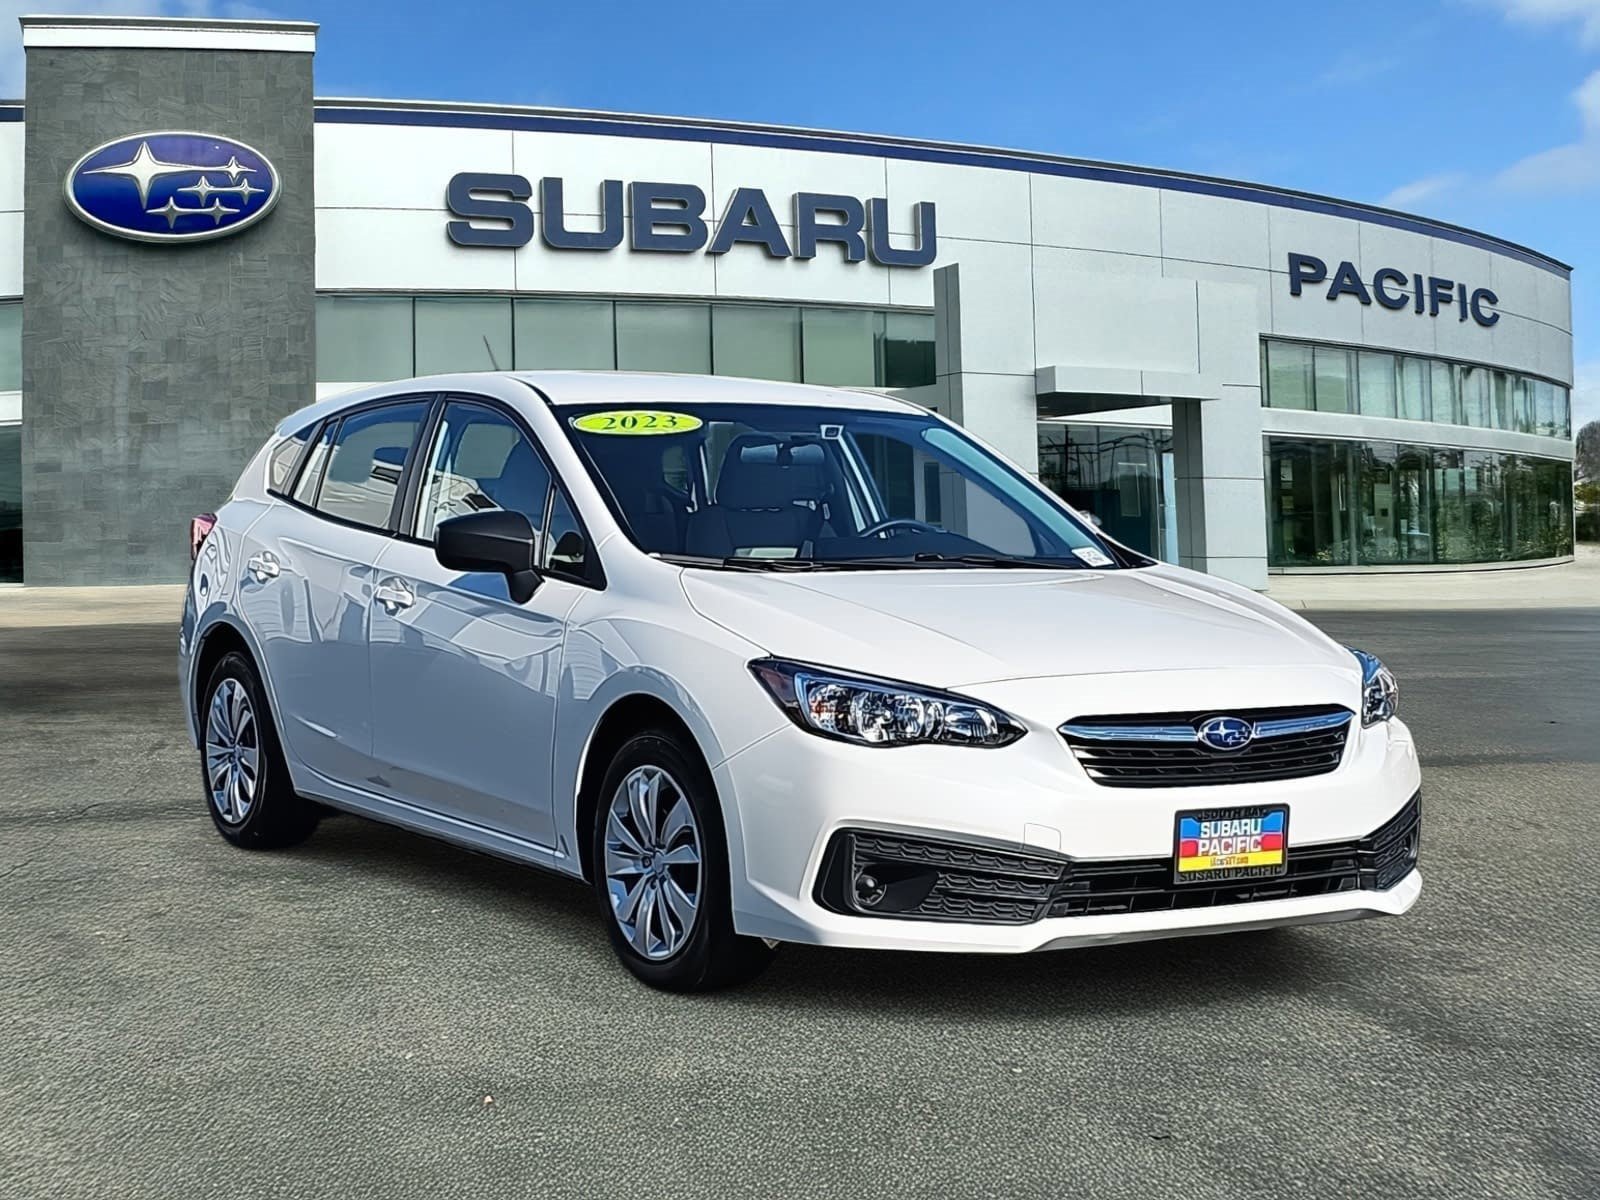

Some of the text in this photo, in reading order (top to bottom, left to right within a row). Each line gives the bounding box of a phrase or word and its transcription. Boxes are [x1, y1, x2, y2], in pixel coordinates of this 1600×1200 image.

[447, 171, 937, 267] SUBARU
[1288, 252, 1500, 327] PACIFIC
[603, 415, 678, 430] 2023
[1201, 818, 1261, 838] SUBARU
[1198, 835, 1262, 856] PACIFIC
[1235, 865, 1282, 878] PACIFIC
